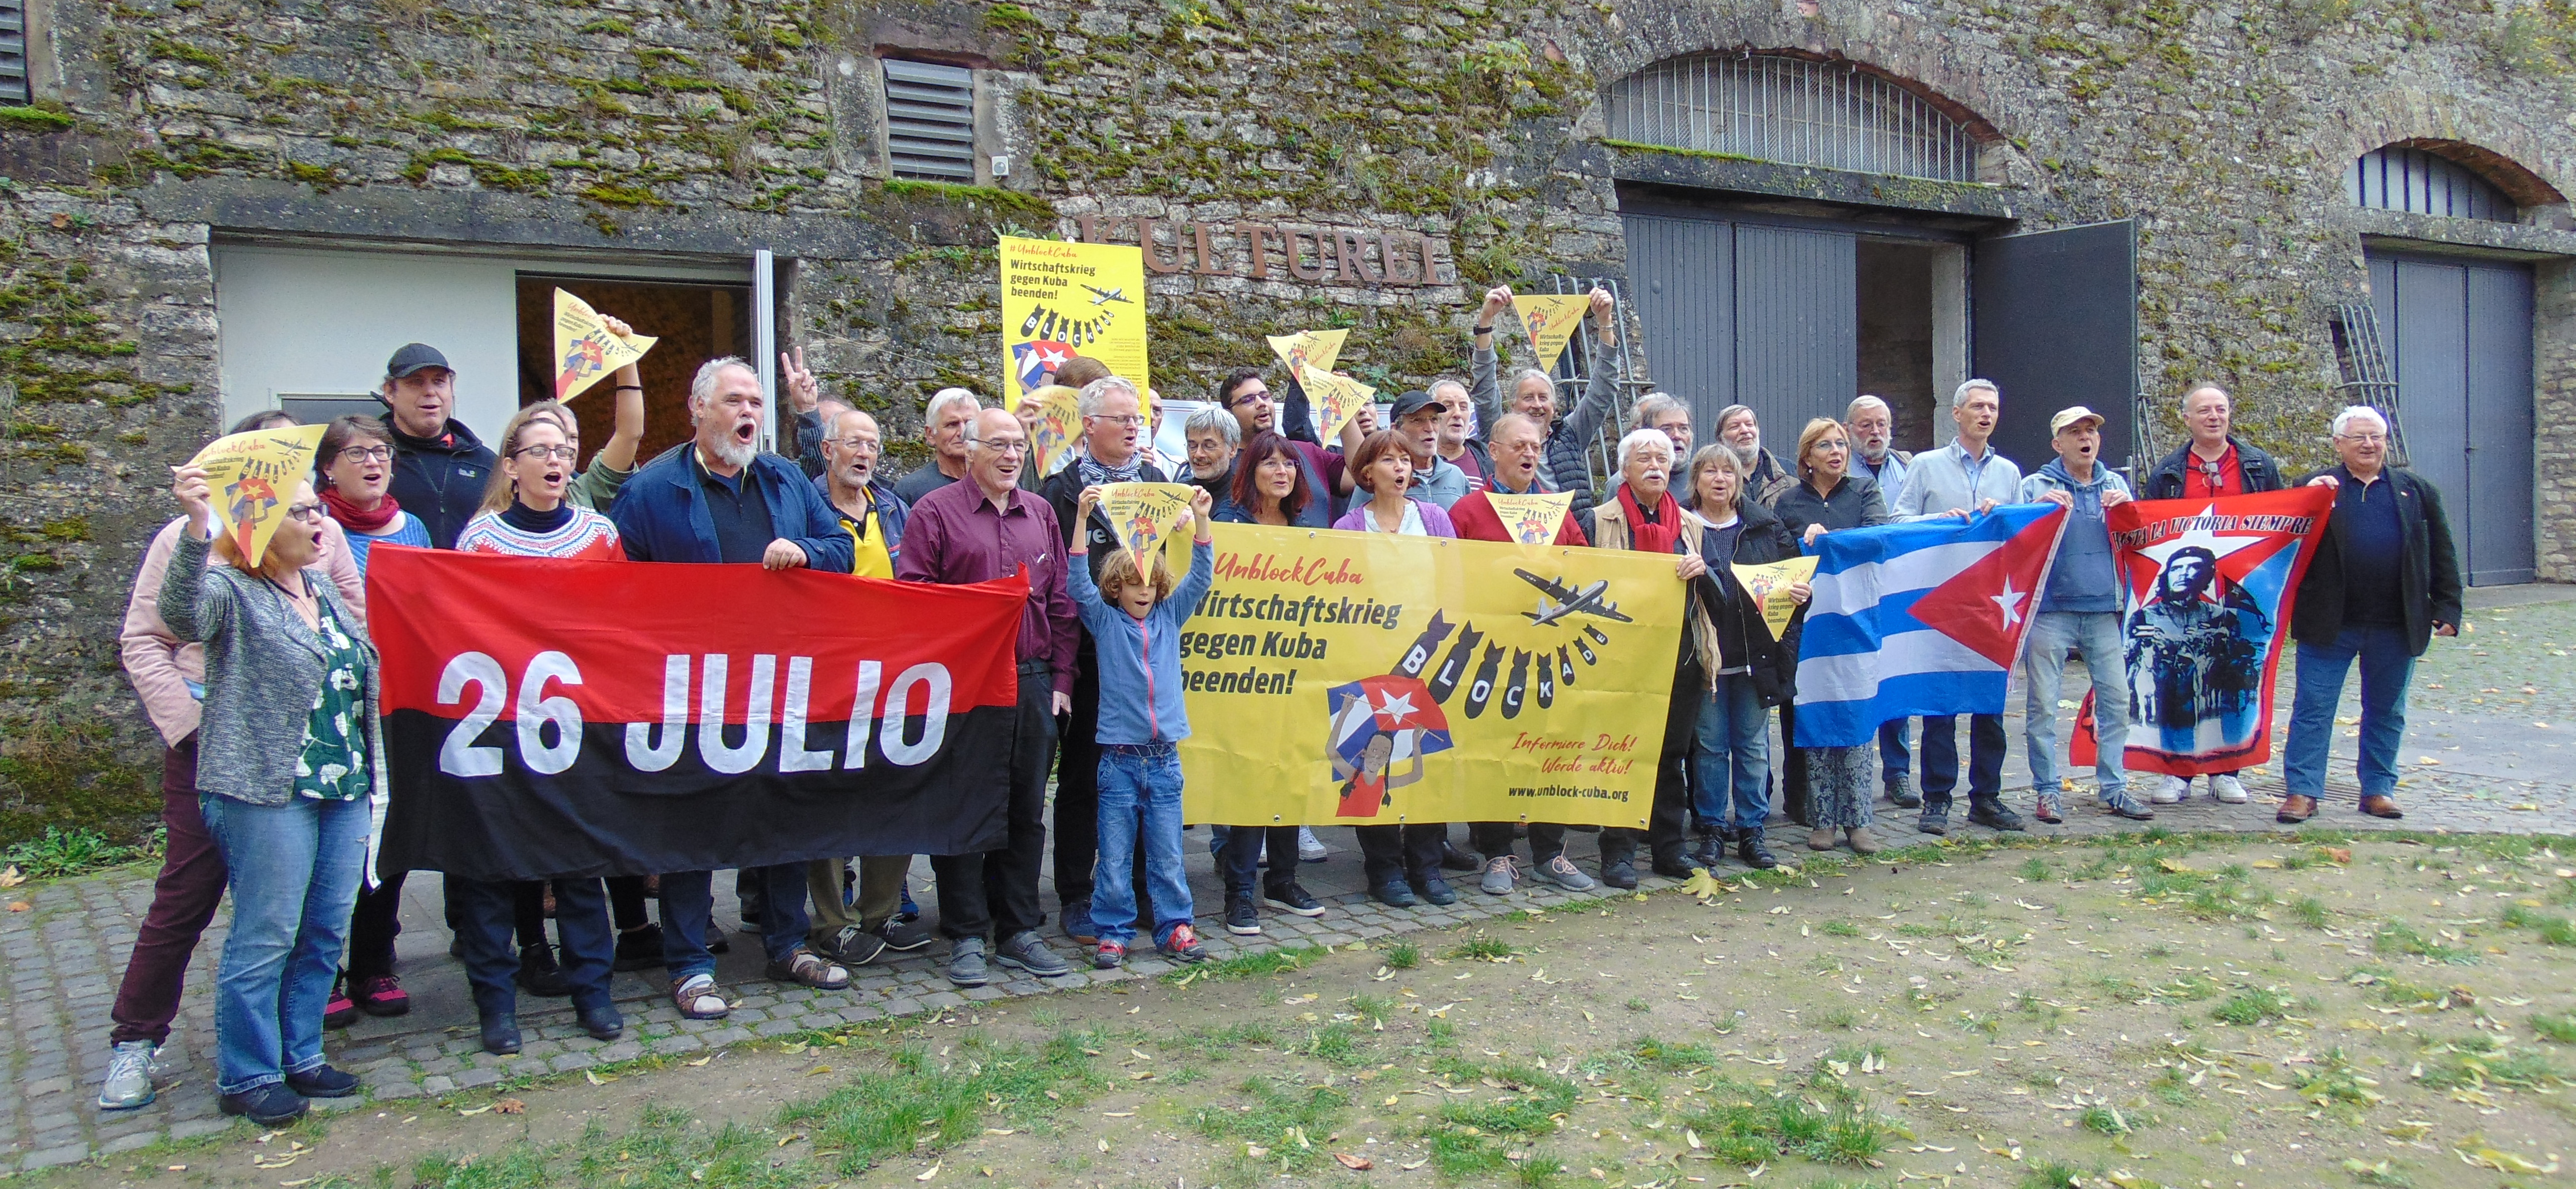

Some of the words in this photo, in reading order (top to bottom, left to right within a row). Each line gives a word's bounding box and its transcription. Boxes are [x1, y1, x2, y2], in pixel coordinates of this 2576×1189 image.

[1010, 244, 1077, 258] #UnblockCuba
[1011, 259, 1096, 276] Wirtschaftskrieg
[1010, 274, 1040, 285] gegen
[1043, 275, 1068, 287] Kuba
[1011, 286, 1058, 300] beenden!
[1111, 488, 1155, 498] UnblockCuba
[2150, 521, 2168, 541] LA
[2169, 515, 2238, 534] VICTORIA
[2240, 515, 2316, 534] SIEMPRE
[1179, 631, 1257, 660] gegen
[1260, 631, 1328, 660] Kuba
[436, 650, 585, 778] 26
[623, 653, 953, 775] JULIO
[1511, 731, 1586, 754] Informiere
[1591, 732, 1638, 752] Dich!
[1541, 754, 1582, 774] Werde
[1589, 756, 1634, 775] aktiv!
[1508, 784, 1629, 802] www.unblock-cuba.org
